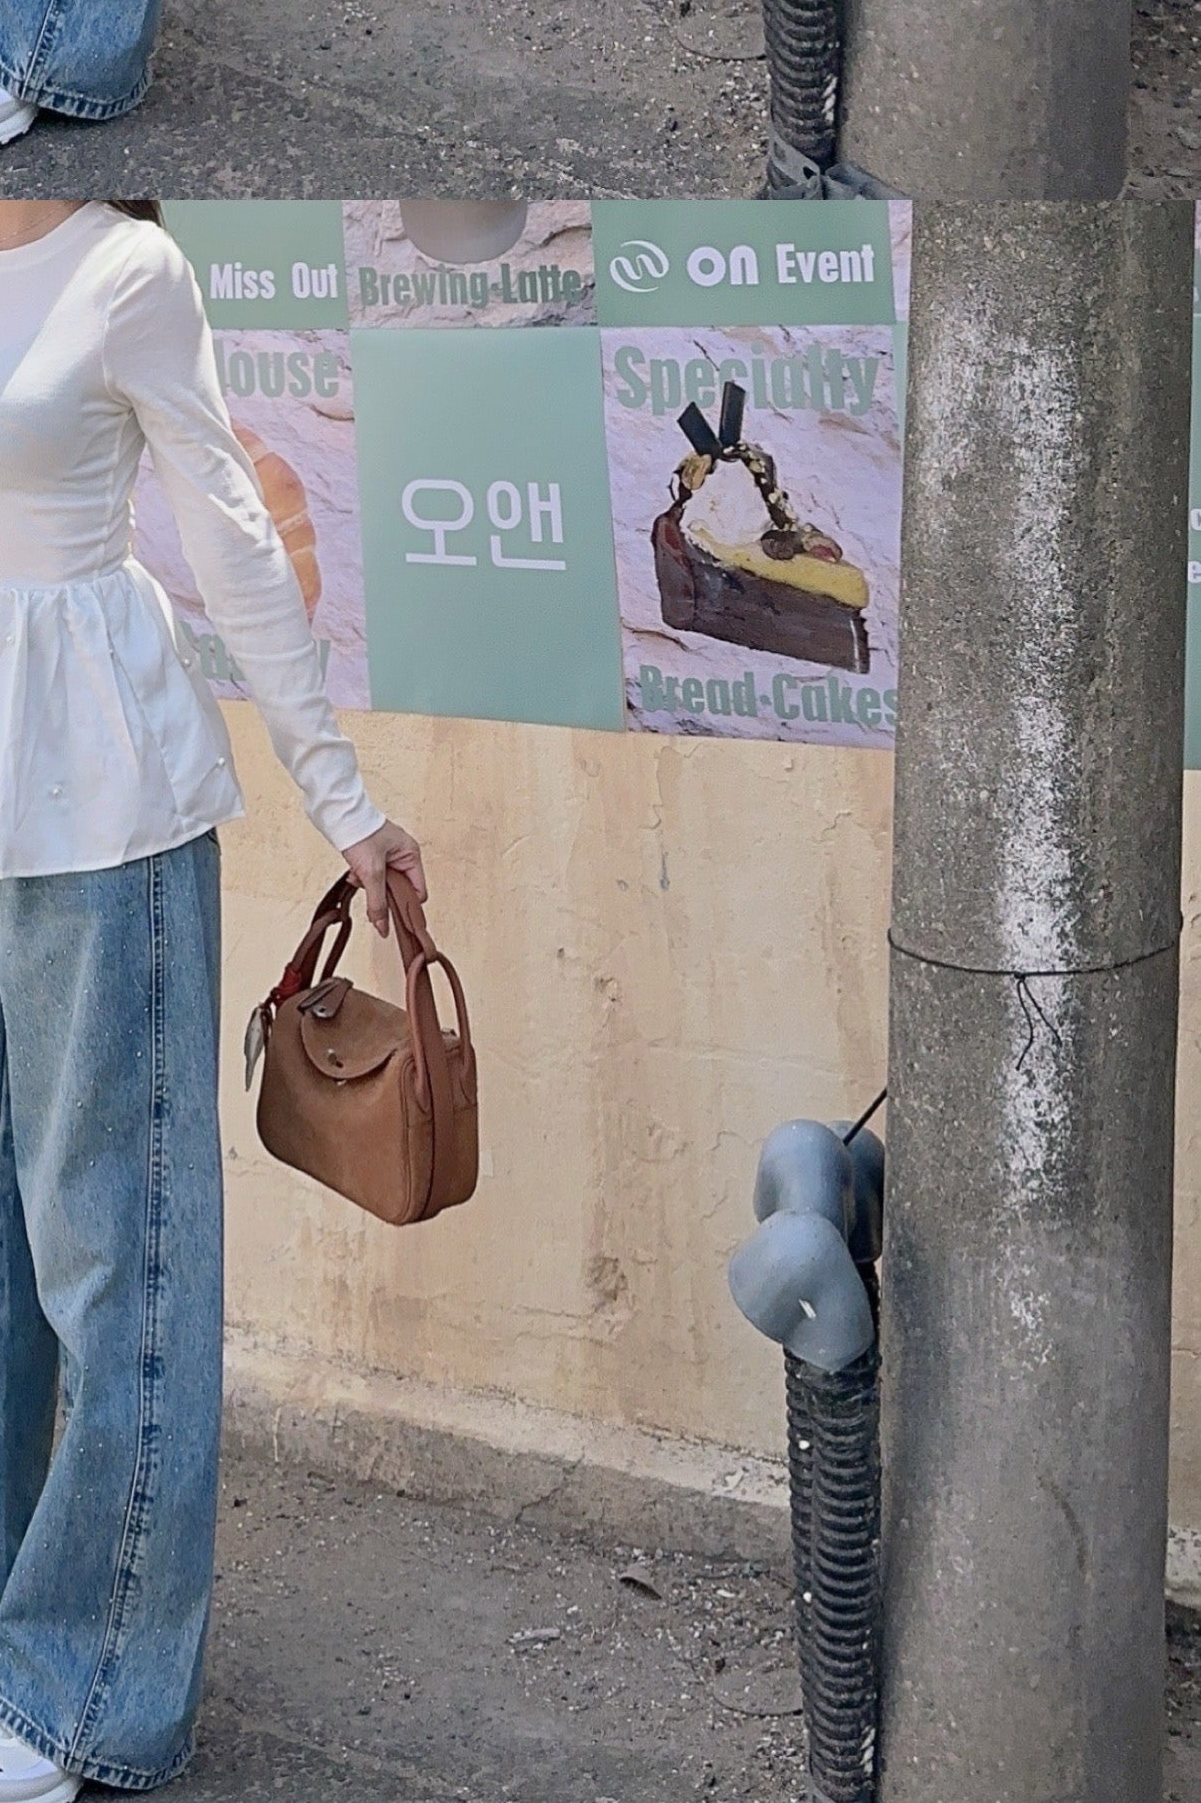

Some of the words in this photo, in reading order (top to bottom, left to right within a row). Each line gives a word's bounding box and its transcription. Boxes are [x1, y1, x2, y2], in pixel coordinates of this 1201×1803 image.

[210, 261, 275, 299] Miss
[292, 262, 338, 299] Out
[776, 242, 875, 284] Event
[402, 478, 566, 571] 오앤
